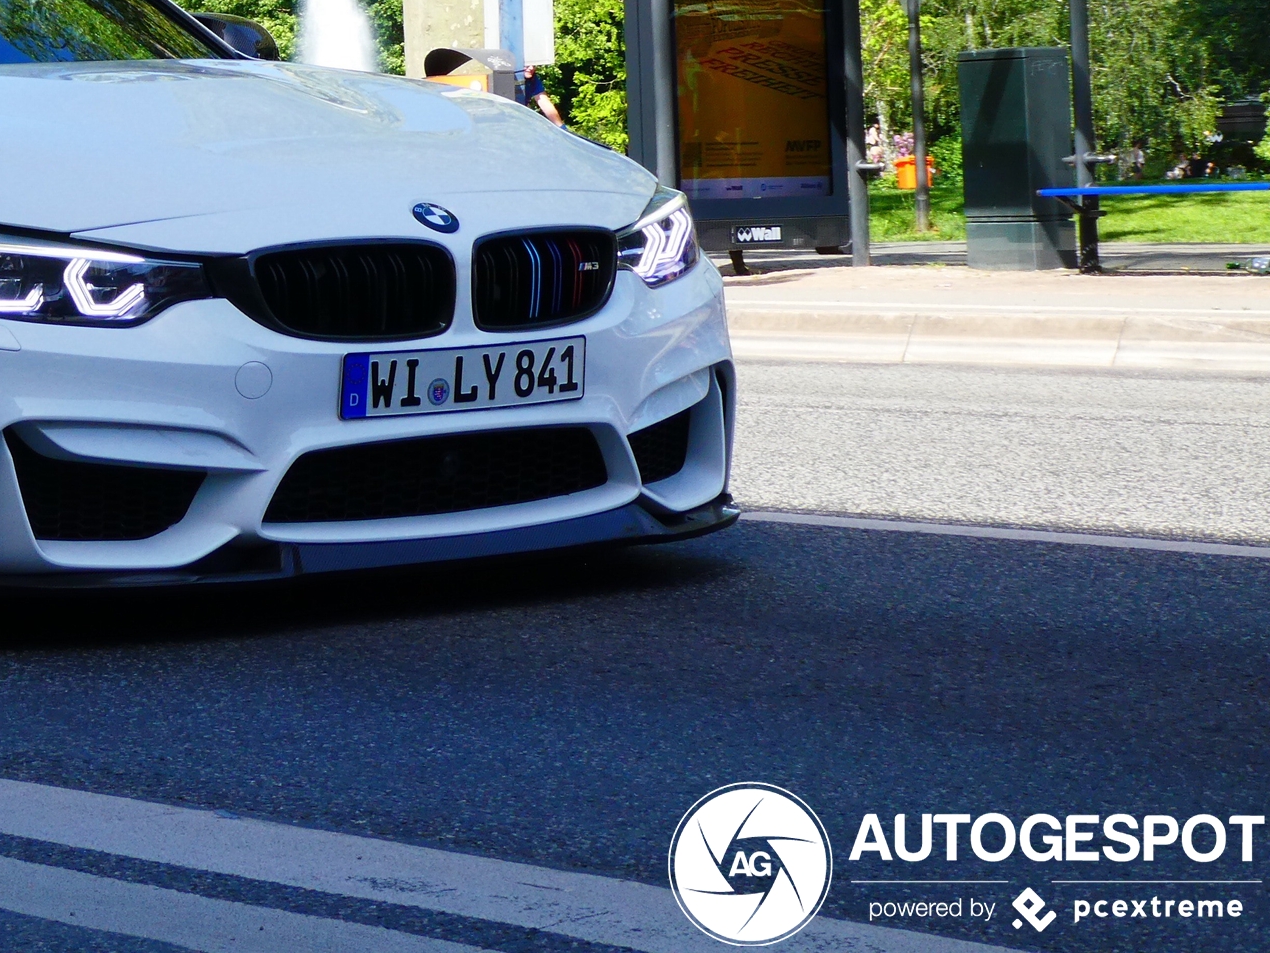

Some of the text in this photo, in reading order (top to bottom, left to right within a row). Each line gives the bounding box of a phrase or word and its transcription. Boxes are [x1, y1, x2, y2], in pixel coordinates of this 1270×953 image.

[700, 58, 825, 99] FREIHEIT
[717, 47, 824, 86] PRESSE
[750, 226, 782, 242] Wall
[578, 261, 599, 271] M3
[371, 345, 578, 409] WI LY 841
[349, 393, 359, 407] D
